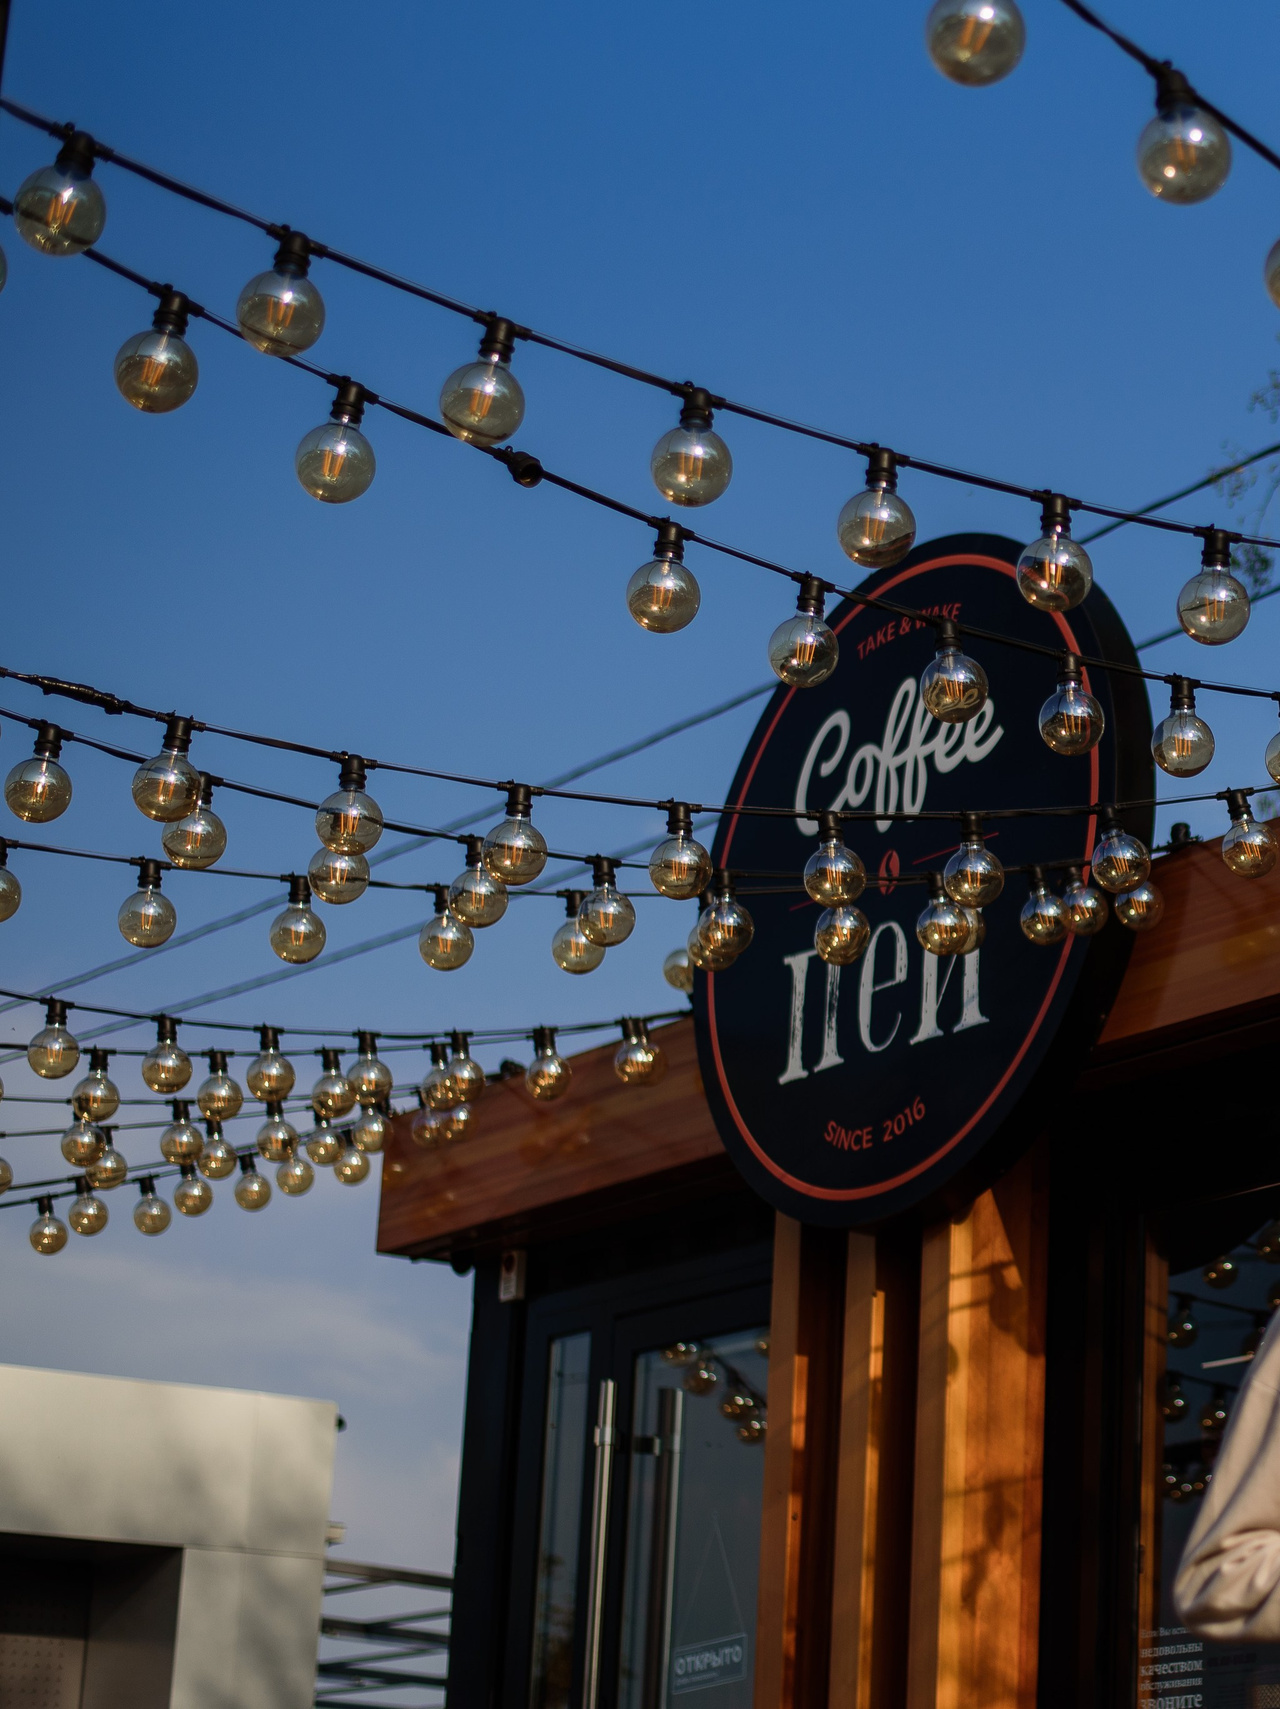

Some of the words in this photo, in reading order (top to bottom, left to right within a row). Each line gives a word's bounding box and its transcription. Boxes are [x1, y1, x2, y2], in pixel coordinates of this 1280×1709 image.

[857, 621, 896, 660] TAKE
[899, 617, 912, 635] &
[795, 677, 1004, 836] Coffee
[824, 1120, 873, 1151] SINCE
[883, 1096, 926, 1142] 2016
[674, 1645, 742, 1675] ОТКРЫТО
[1141, 1643, 1203, 1658] недовольны
[1141, 1660, 1203, 1676] качеством
[1141, 1694, 1203, 1709] звоните
